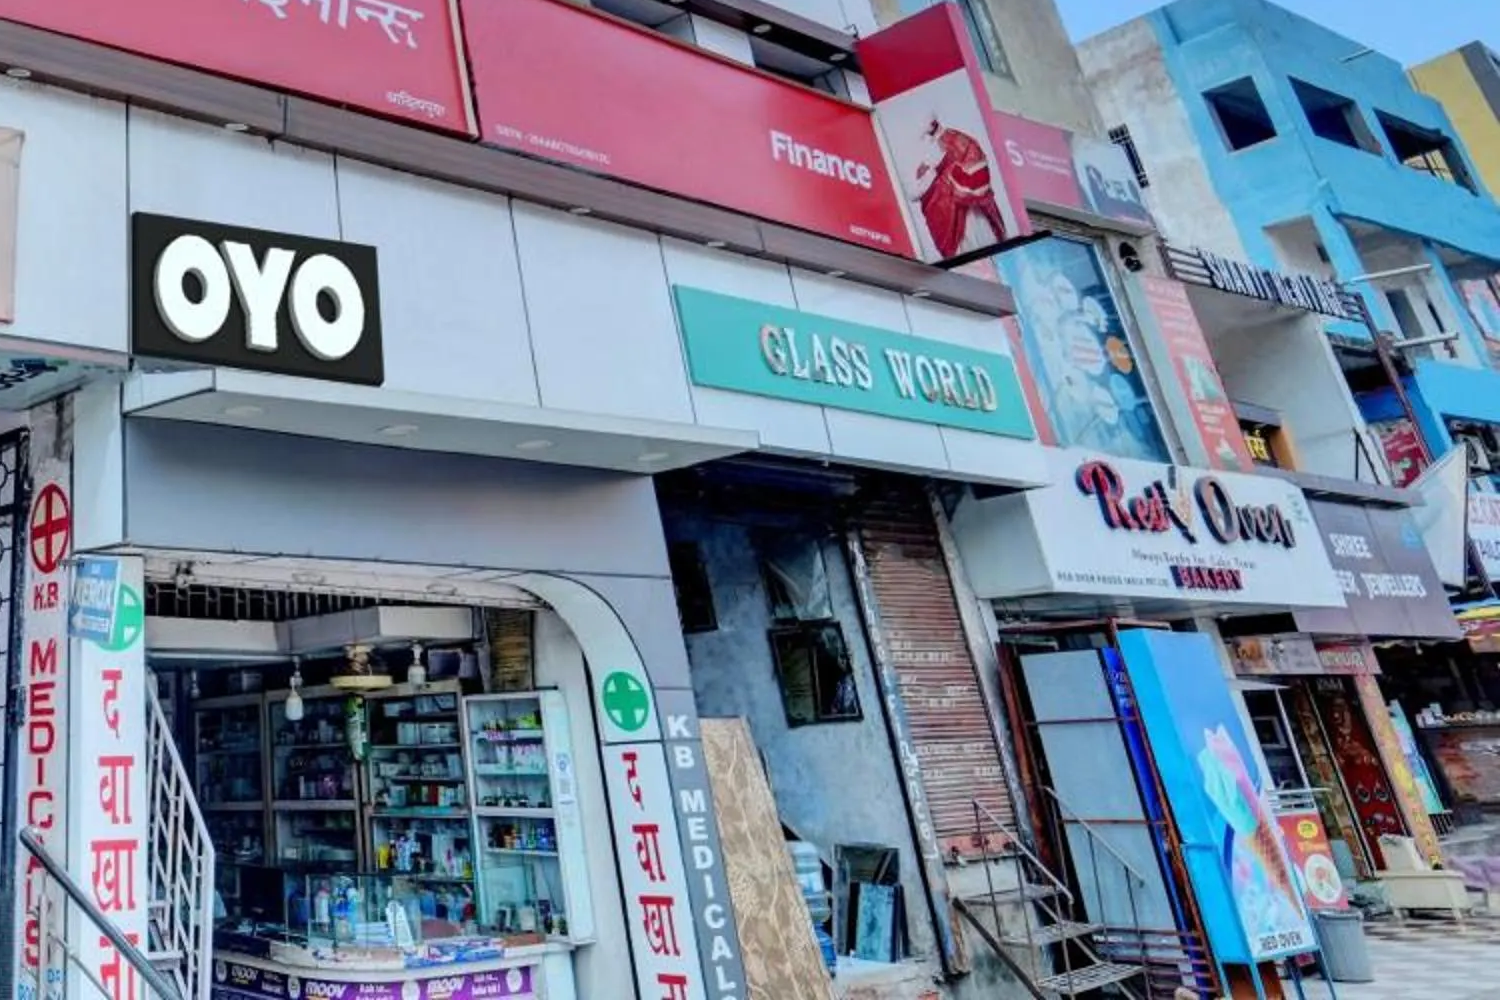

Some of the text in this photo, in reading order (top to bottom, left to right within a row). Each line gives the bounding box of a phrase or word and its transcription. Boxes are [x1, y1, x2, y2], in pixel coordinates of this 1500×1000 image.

[769, 129, 873, 190] Finance
[153, 233, 366, 362] OYO
[759, 322, 999, 413] GLASS WORLD
[1193, 474, 1298, 549] Oven
[1360, 571, 1428, 600] JEWELLERS
[679, 789, 740, 1000] MEDICAL
